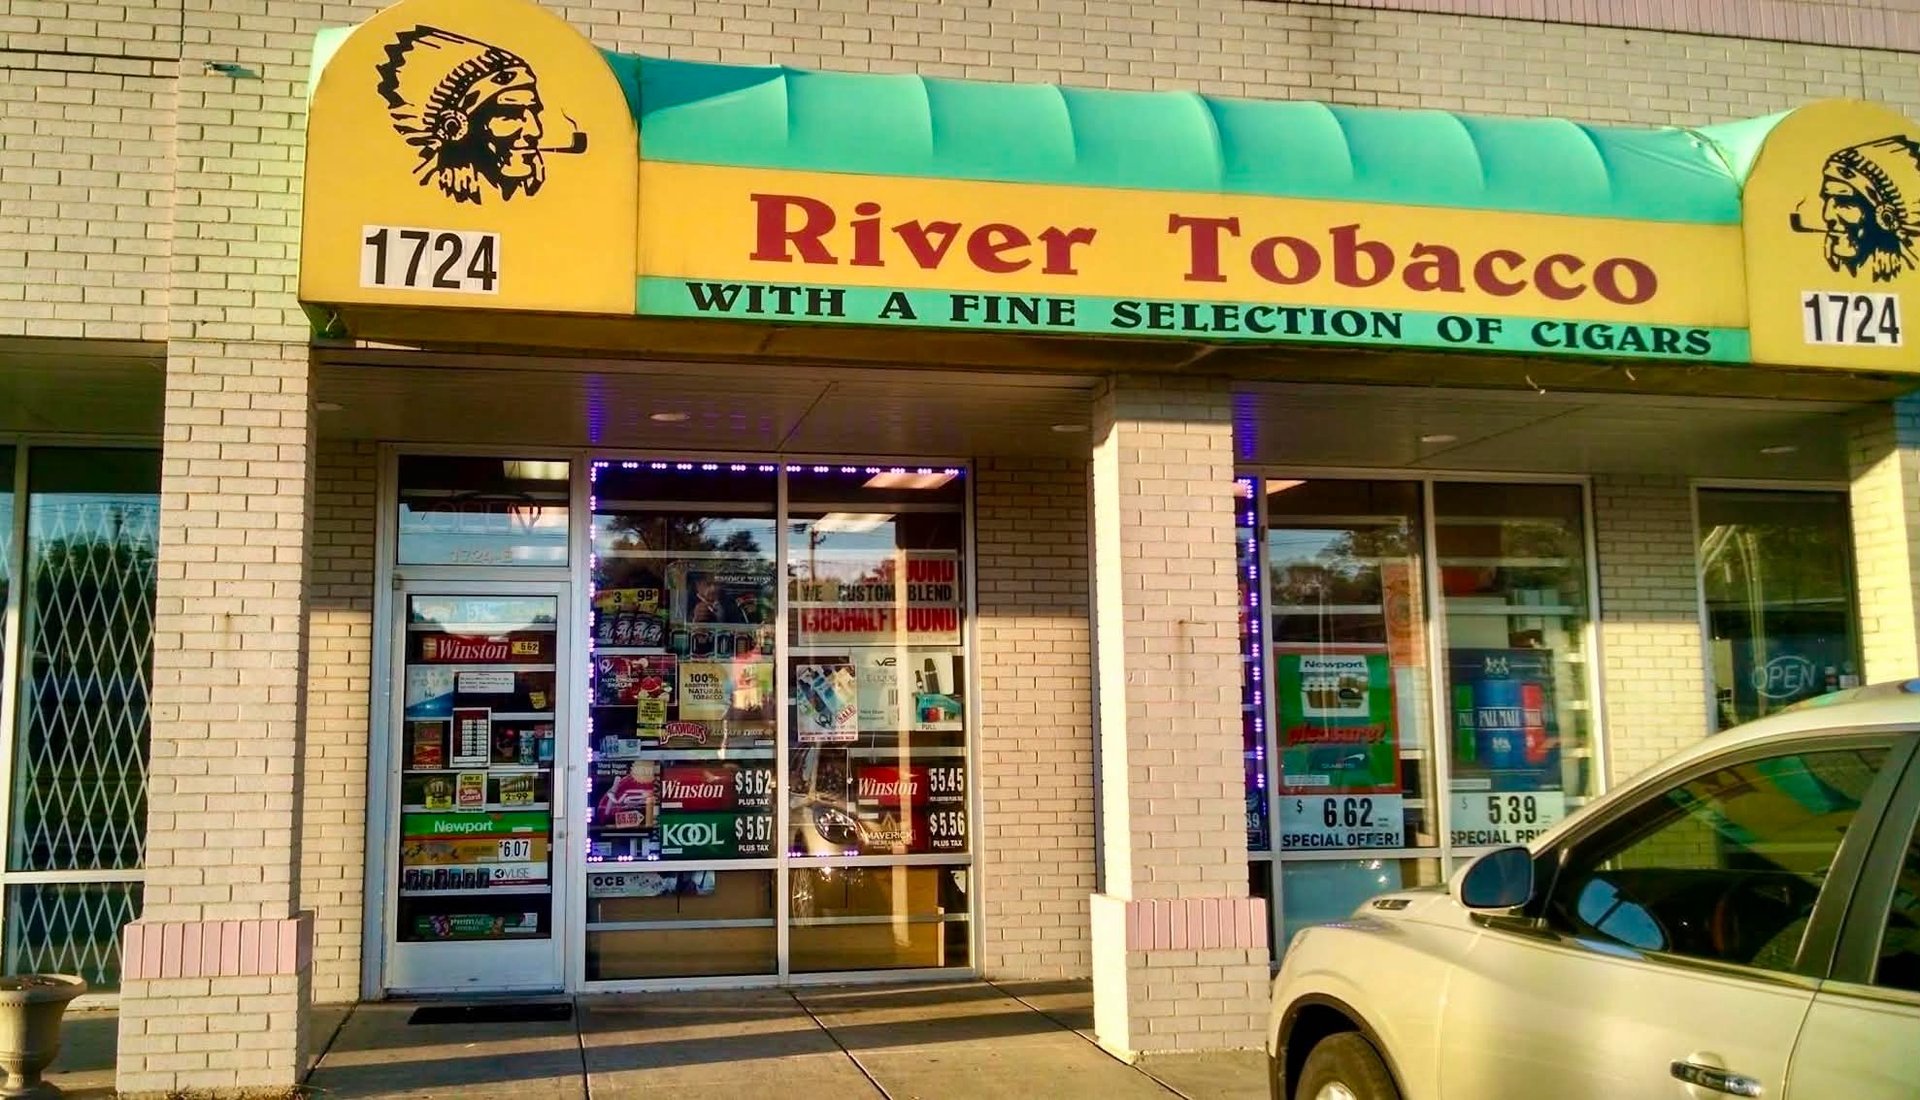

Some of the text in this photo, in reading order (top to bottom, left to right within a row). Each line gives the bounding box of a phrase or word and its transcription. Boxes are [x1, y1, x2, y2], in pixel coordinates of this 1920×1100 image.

[750, 193, 1658, 305] River Tobacco
[365, 228, 497, 291] 1724
[685, 282, 1712, 355] WITH A FINE SELECTION OF CIGARS
[1804, 293, 1899, 343] 1724
[613, 591, 622, 603] 3
[907, 584, 952, 602] BLEND
[439, 639, 509, 660] Winston
[1303, 659, 1365, 670] Newport
[690, 673, 719, 683] 100%
[1751, 664, 1815, 690] OPEN
[661, 780, 725, 799] Winston
[735, 769, 772, 795] $5.62
[858, 778, 918, 797] Winston
[738, 798, 756, 806] PLUS
[1488, 795, 1537, 825] 5.39
[1297, 799, 1303, 814] $
[1323, 797, 1373, 828] 6.62
[434, 820, 494, 834] Newport
[735, 815, 772, 841] $5.67
[929, 811, 965, 837] $5.56
[662, 822, 725, 847] KOOL
[951, 839, 963, 847] TAX
[1282, 832, 1399, 847] SPECIAL OFFER!
[738, 844, 770, 852] PLUS TAX
[593, 876, 625, 886] OCB
